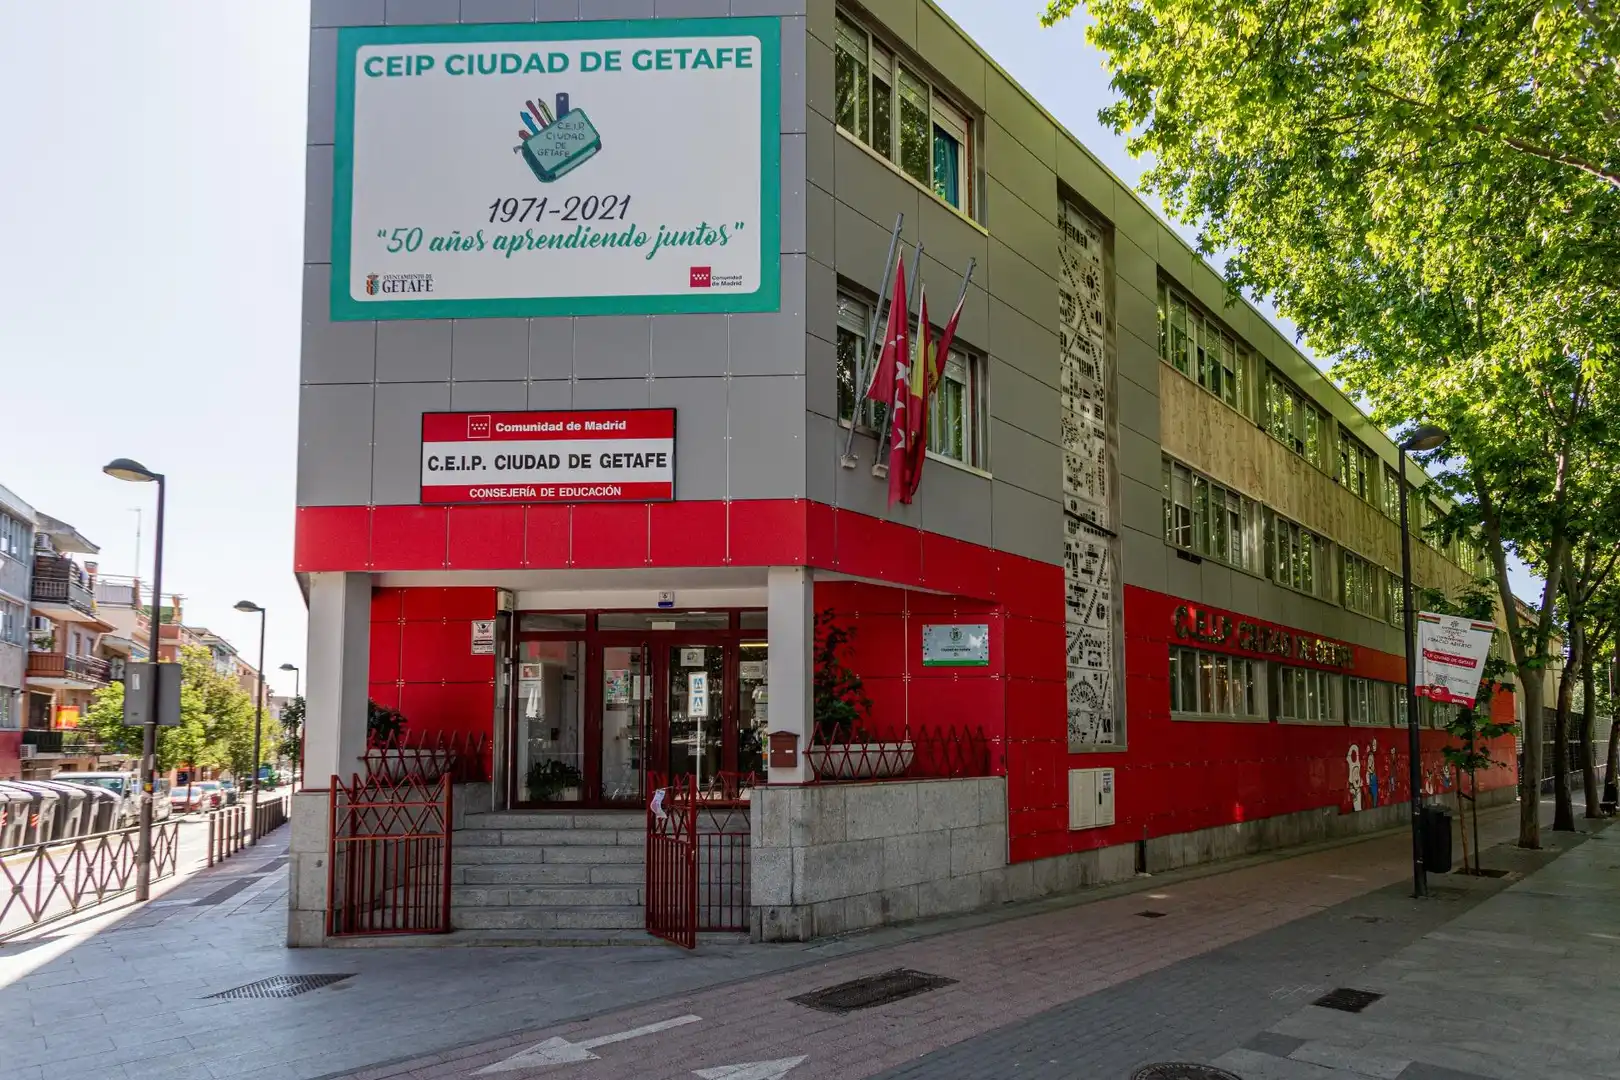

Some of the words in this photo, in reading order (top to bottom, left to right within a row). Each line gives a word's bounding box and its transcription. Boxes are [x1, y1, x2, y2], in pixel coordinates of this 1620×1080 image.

[364, 54, 435, 78] CEIP
[445, 51, 570, 75] CIUDAD
[580, 49, 622, 72] DE
[632, 46, 753, 70] GETAFE
[546, 132, 585, 140] CIUDAD
[555, 141, 567, 149] DE
[488, 194, 632, 223] 1971-2021
[429, 229, 488, 252] años
[493, 223, 652, 258] aprendiendo
[382, 279, 434, 293] GETAFE
[495, 421, 563, 432] Comunidad
[566, 421, 581, 431] de
[585, 420, 627, 431] Madrid
[428, 455, 487, 471] C.E.I.P.
[494, 454, 560, 470] CIUDAD
[568, 453, 592, 469] DE
[600, 452, 667, 469] GETAFE
[469, 485, 537, 498] CONSEJERÍA
[540, 487, 555, 497] DE
[559, 484, 622, 497] EDUCACIÓN
